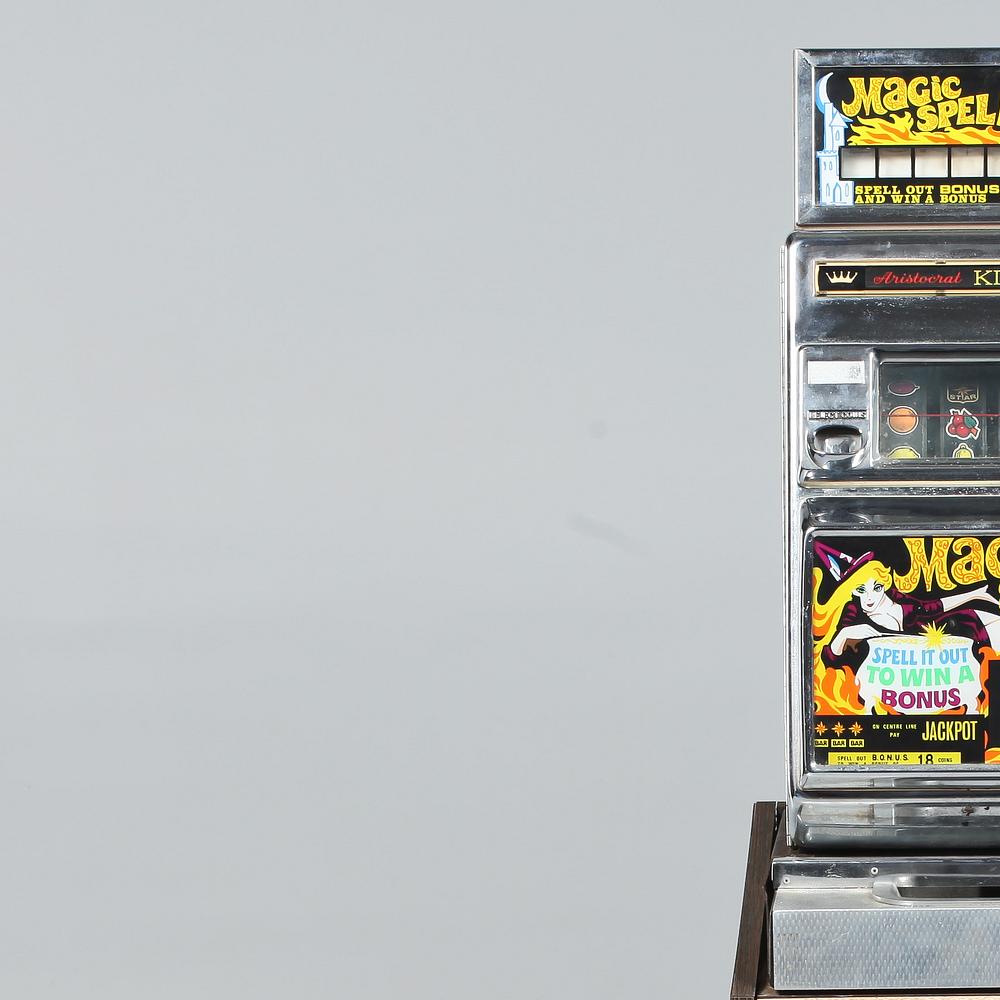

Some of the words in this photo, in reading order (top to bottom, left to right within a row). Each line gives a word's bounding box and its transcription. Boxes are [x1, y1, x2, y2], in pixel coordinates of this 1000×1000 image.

[854, 185, 901, 195] SPELL
[906, 185, 935, 195] OUT
[939, 184, 1000, 194] BONUS
[854, 194, 886, 204] AND
[891, 194, 924, 204] WIN
[924, 194, 935, 204] A
[939, 194, 987, 204] BONUS
[872, 270, 963, 286] Aristocrat
[871, 647, 918, 666] SPELL
[921, 648, 936, 665] IT
[939, 647, 969, 665] OUT
[866, 665, 896, 686] TO
[900, 666, 951, 687] WIN
[958, 665, 976, 684] A
[880, 687, 961, 710] BONUS
[921, 720, 978, 741] JACKPOT
[917, 753, 934, 765] 18
